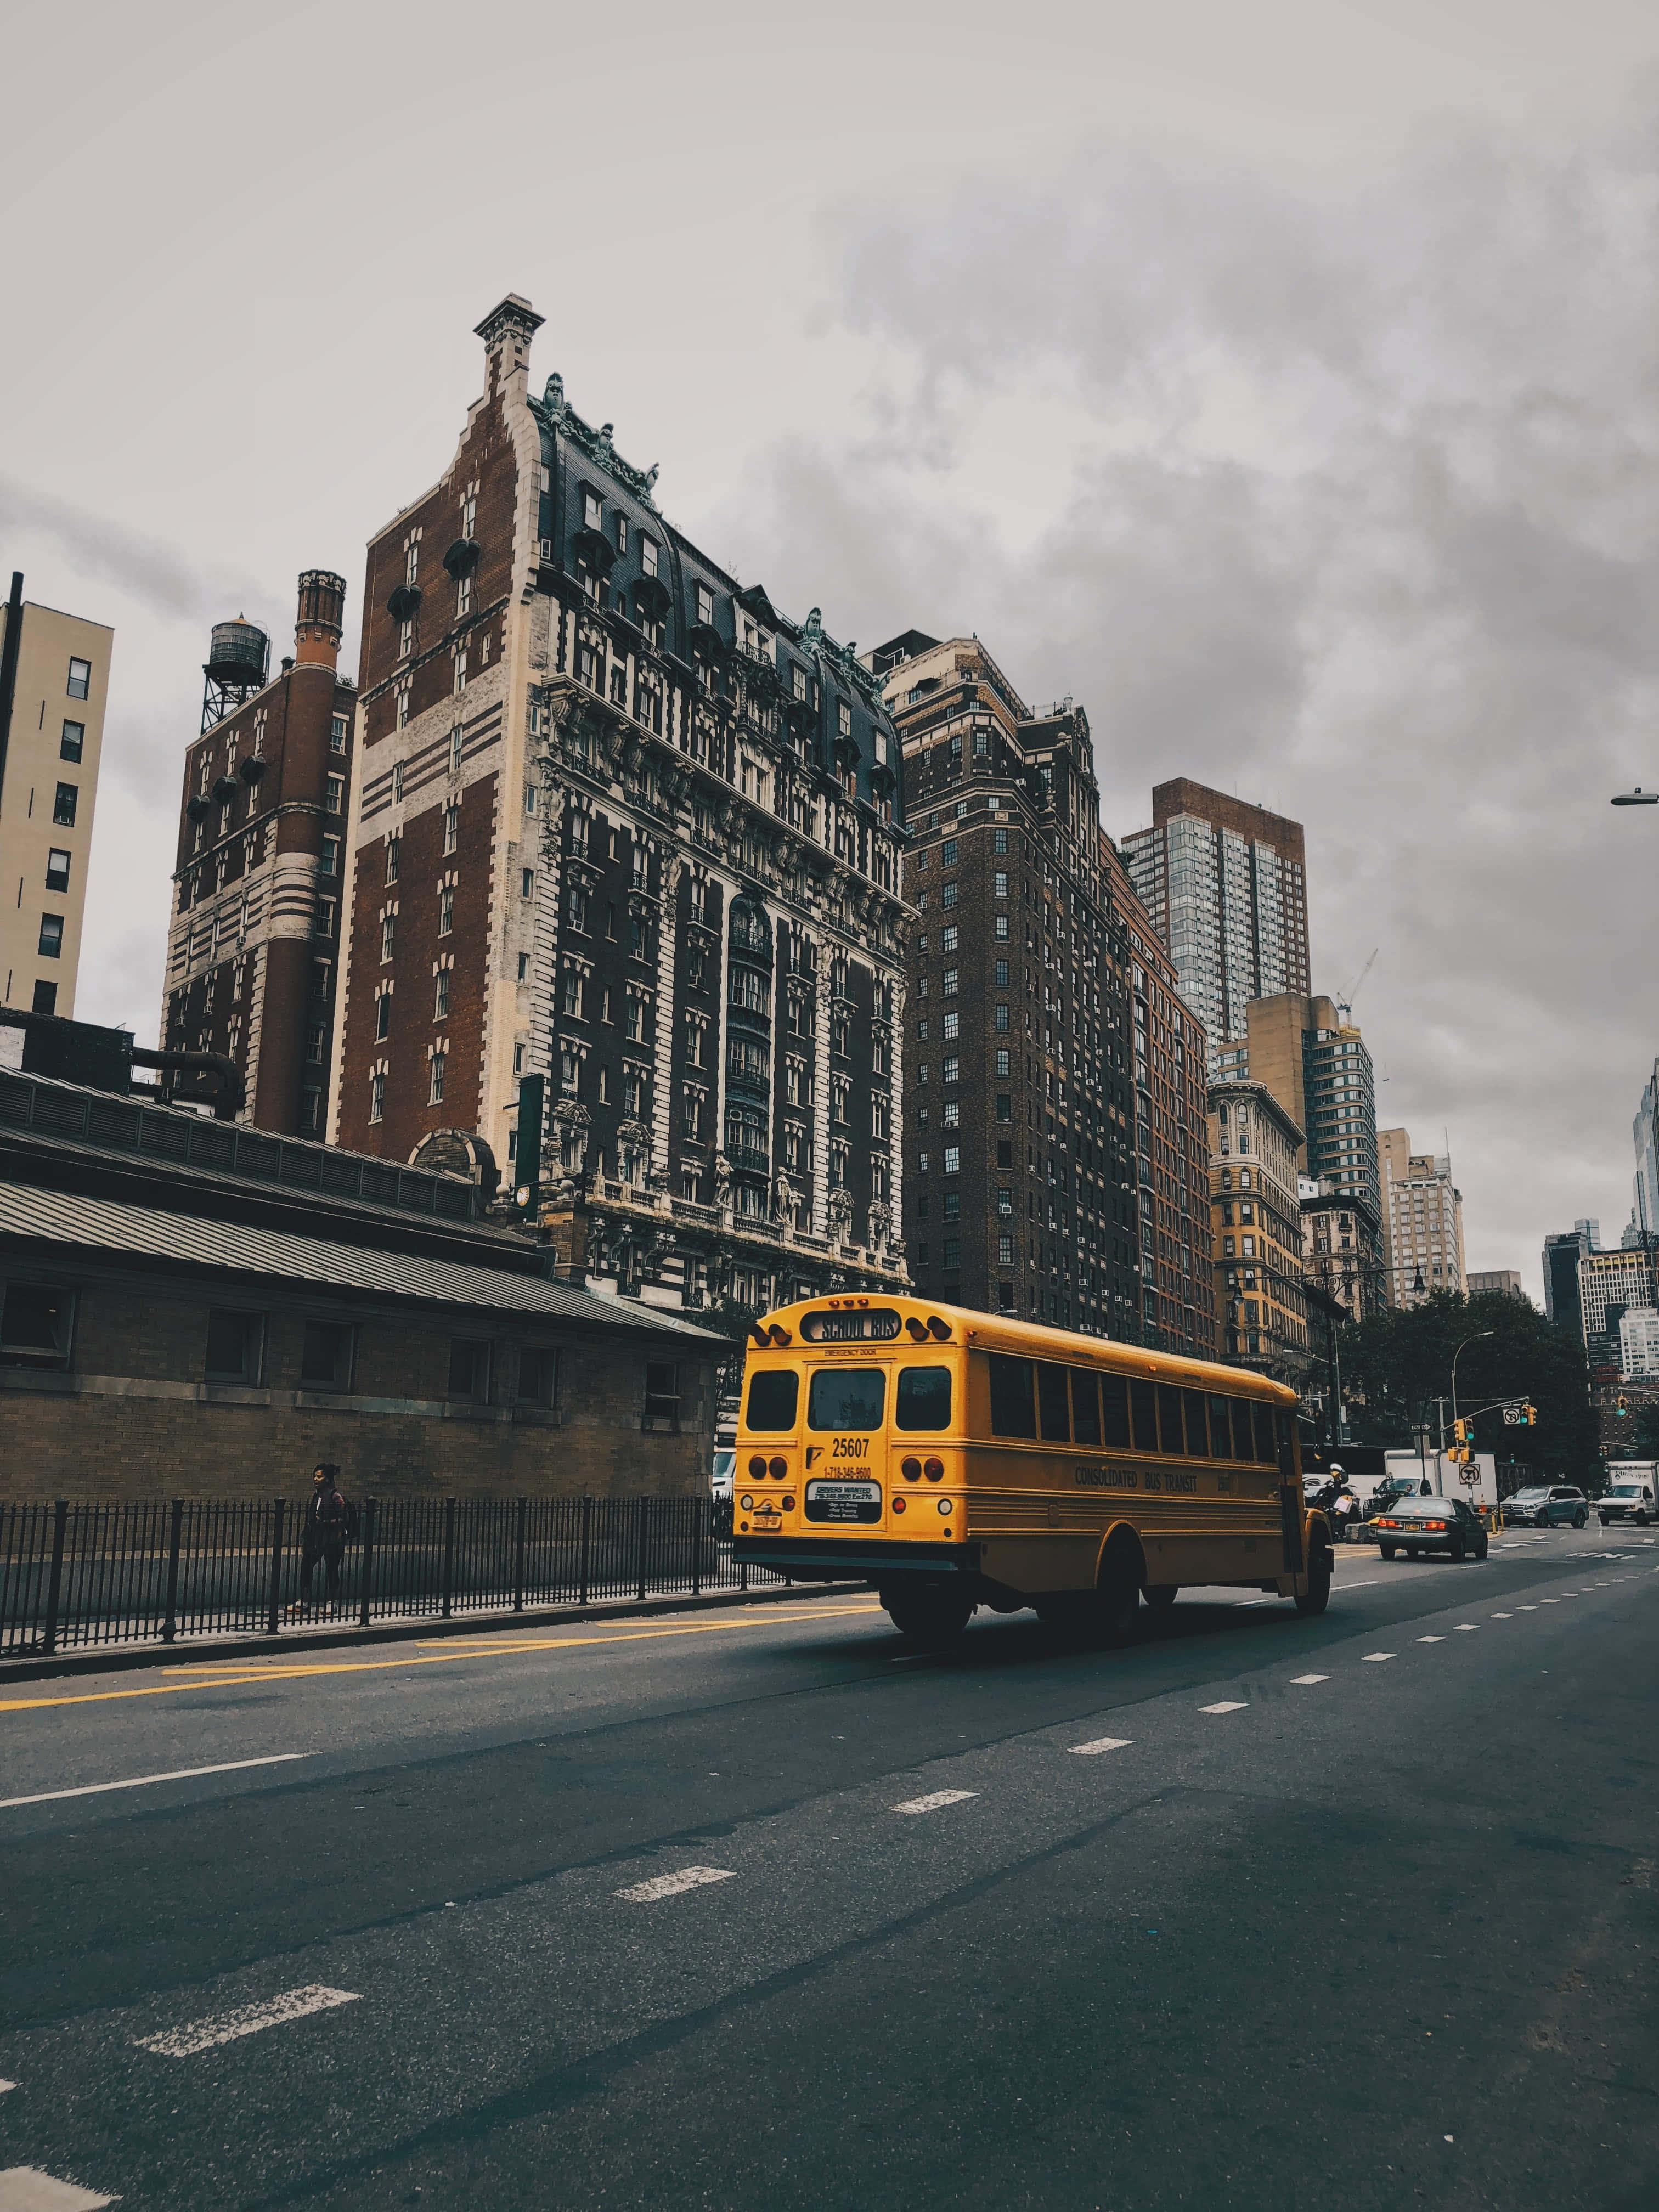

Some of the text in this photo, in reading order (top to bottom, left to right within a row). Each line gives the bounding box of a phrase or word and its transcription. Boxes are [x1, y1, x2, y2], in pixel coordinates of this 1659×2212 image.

[822, 1316, 895, 1338] SCHOOL BUS
[833, 1438, 870, 1458] 25607
[1075, 1466, 1137, 1488] CONSOLIDATED
[1145, 1472, 1161, 1491] BUS
[1164, 1474, 1197, 1493] TRANSIT
